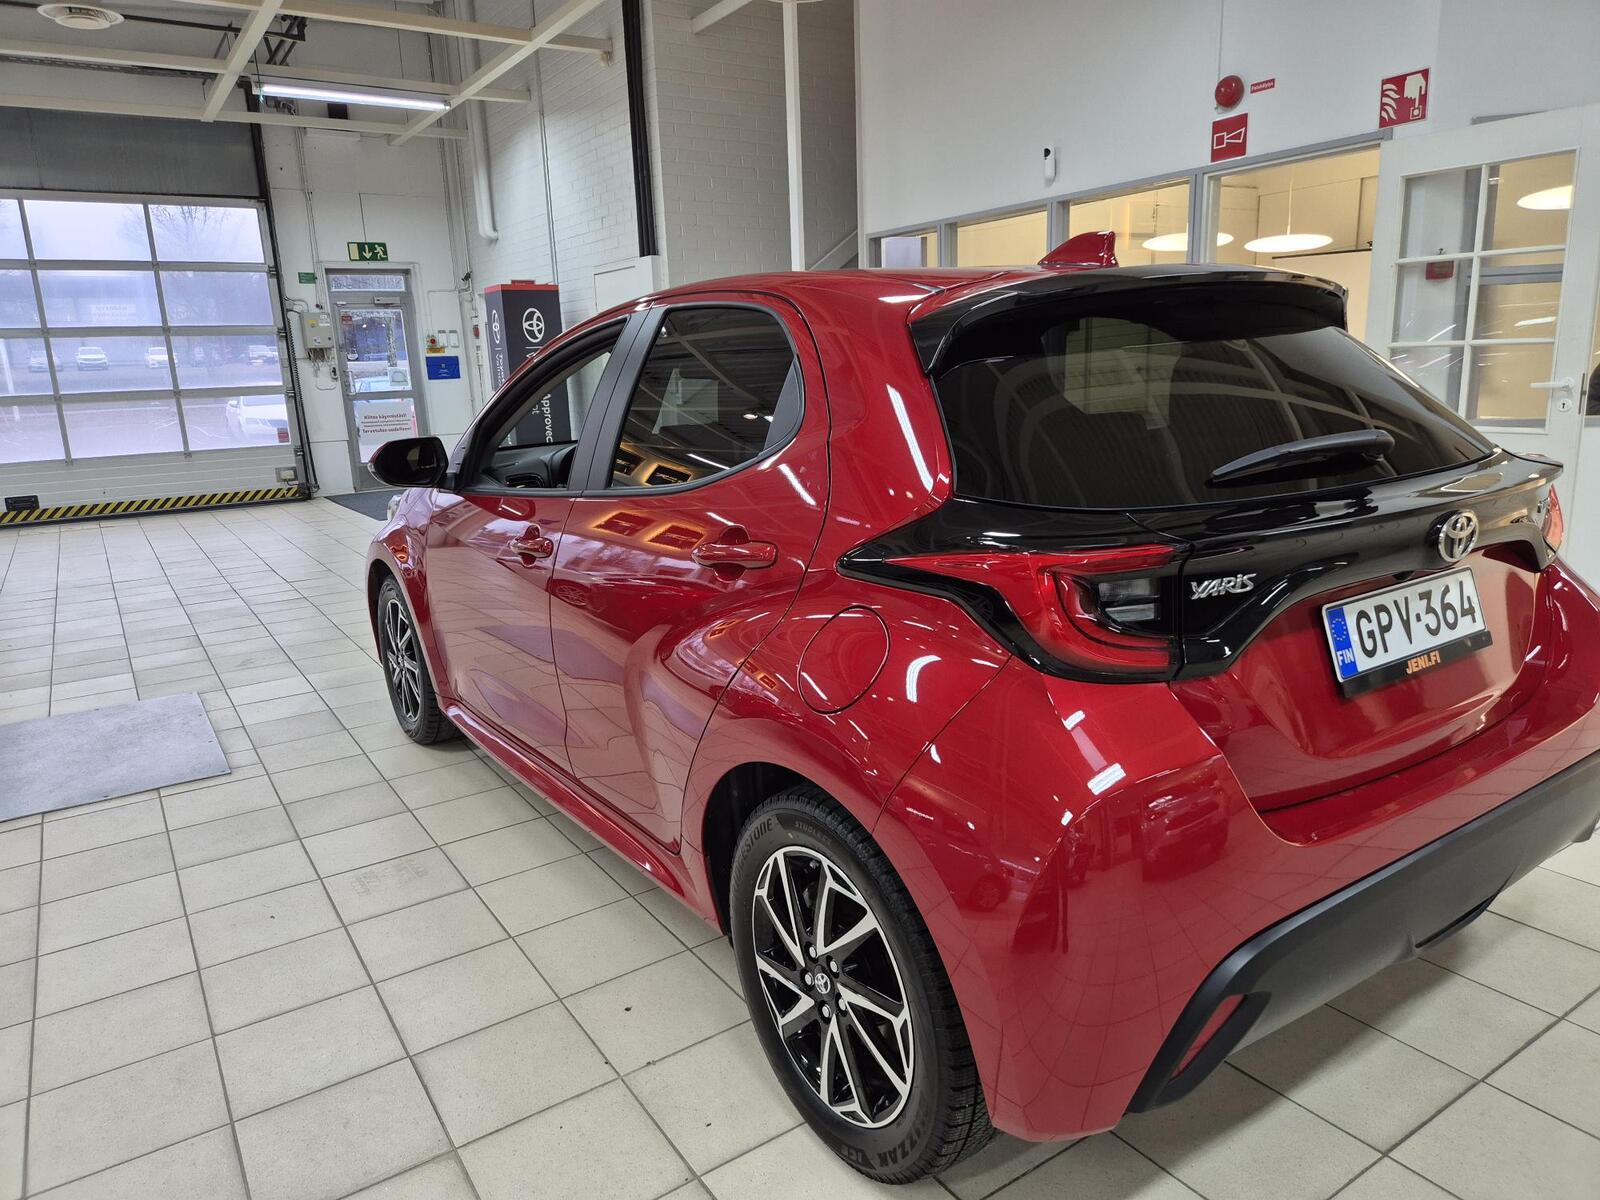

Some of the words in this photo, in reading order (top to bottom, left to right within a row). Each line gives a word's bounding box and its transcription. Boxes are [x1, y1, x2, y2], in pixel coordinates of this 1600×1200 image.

[1356, 580, 1477, 659] GPV-364
[1336, 648, 1355, 666] FIN
[1405, 650, 1441, 675] JENI.FI
